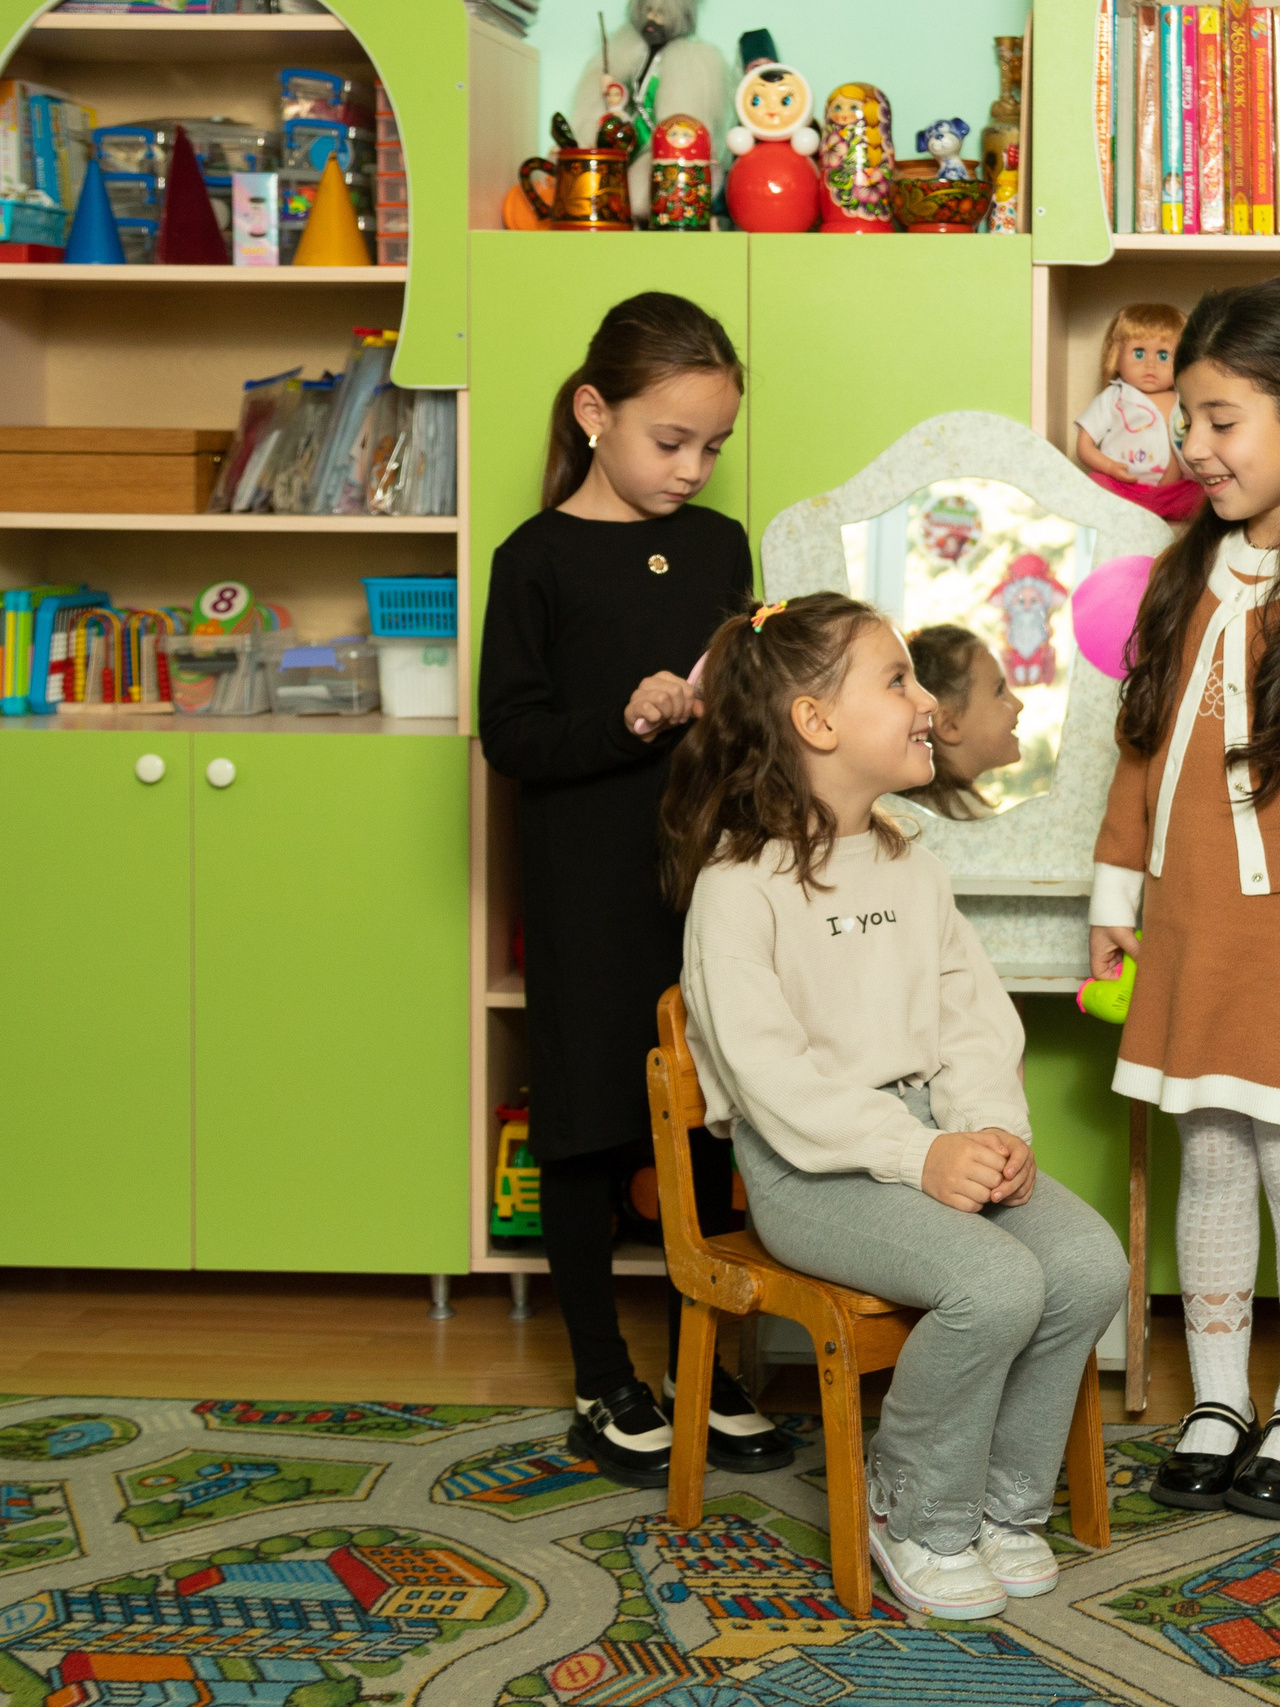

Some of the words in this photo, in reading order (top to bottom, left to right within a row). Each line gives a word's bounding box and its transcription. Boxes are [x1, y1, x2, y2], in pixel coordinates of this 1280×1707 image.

[1231, 21, 1247, 54] 365
[1182, 65, 1193, 110] Сказки
[1233, 54, 1246, 108] СКАЗОК
[1183, 120, 1193, 172] Киплинг
[1183, 175, 1195, 225] Редьярд
[211, 586, 238, 614] 8
[826, 916, 842, 937] I
[856, 910, 897, 934] you
[564, 1660, 590, 1683] H
